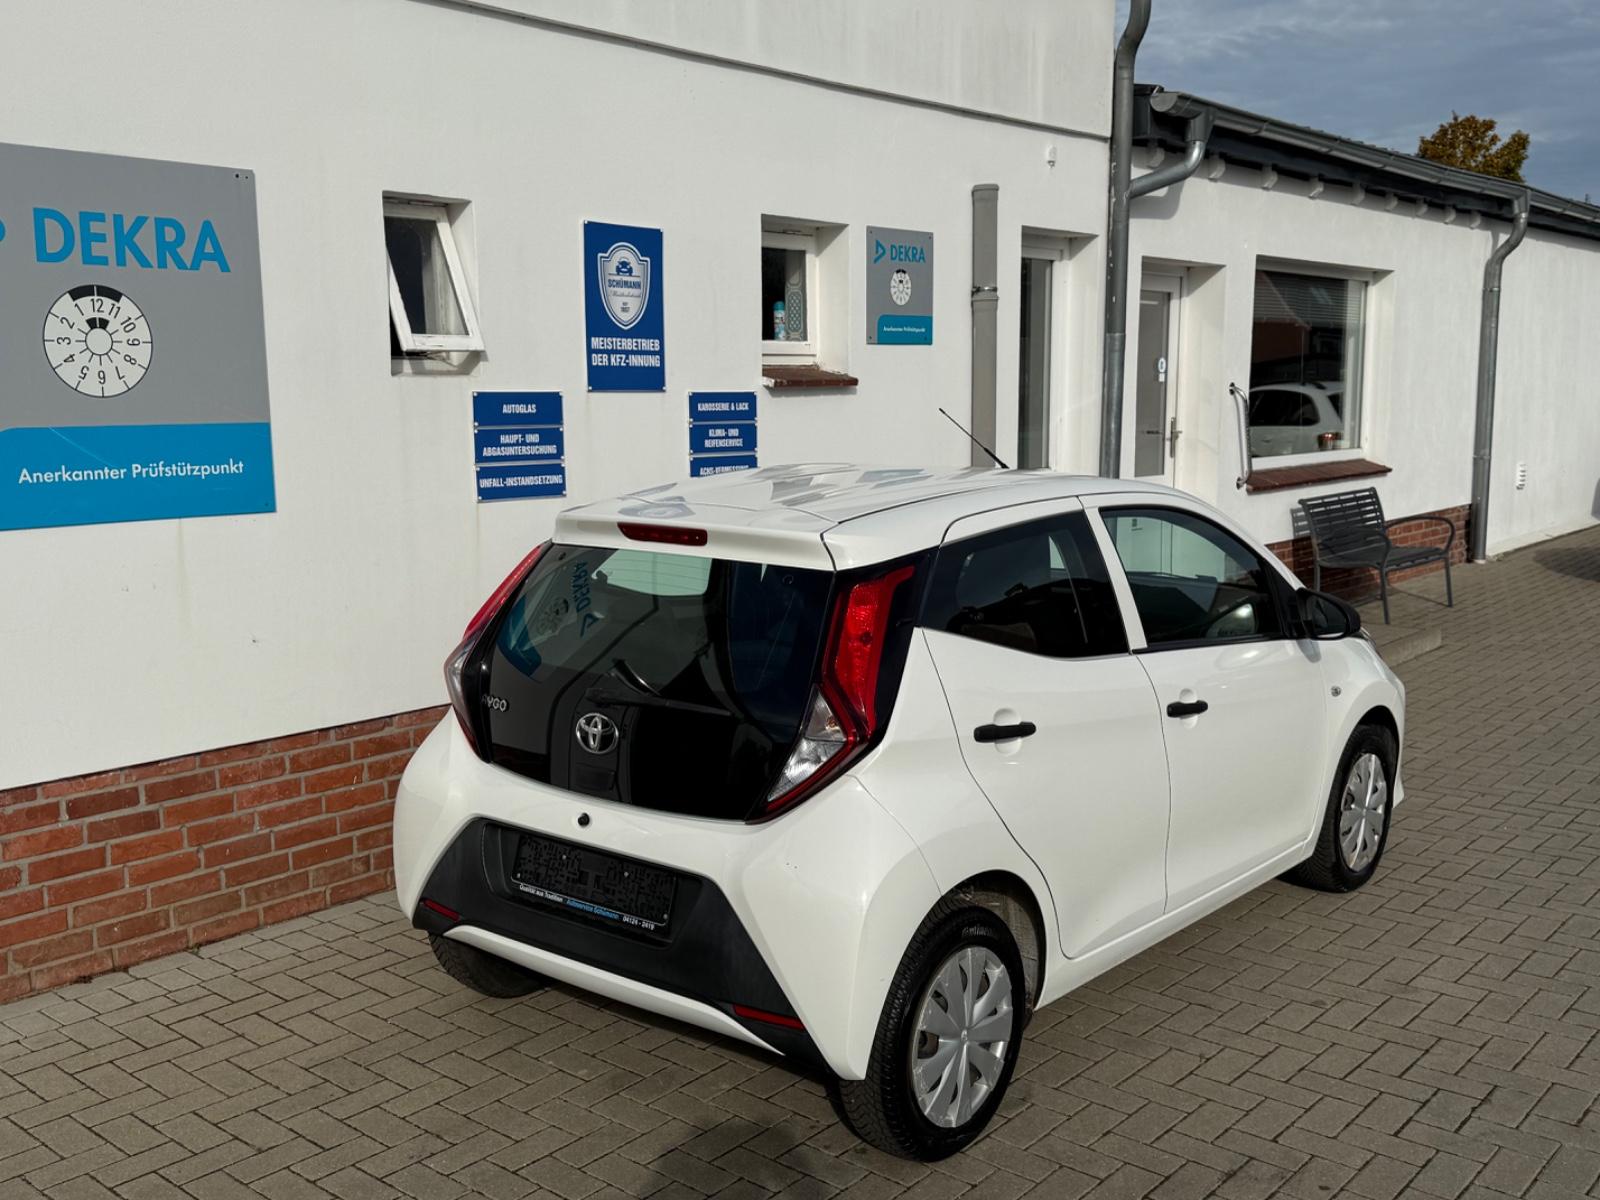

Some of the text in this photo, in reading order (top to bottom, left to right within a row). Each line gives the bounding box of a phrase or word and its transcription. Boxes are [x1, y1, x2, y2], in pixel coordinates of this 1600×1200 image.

[32, 207, 231, 272] DEKRA
[890, 244, 926, 263] DEKRA
[608, 278, 641, 289] SCHÜMANN
[74, 303, 84, 316] 1
[90, 298, 104, 313] 12
[108, 303, 121, 319] 11
[60, 317, 75, 329] 2
[120, 316, 136, 333] 10
[56, 336, 71, 345] 3
[127, 338, 141, 346] 9
[591, 337, 660, 351] MEISTERBETRIEB
[63, 353, 75, 363] 4
[123, 354, 137, 365] 8
[592, 353, 660, 367] DER KFZ-INNUNG
[78, 365, 90, 380] 5
[97, 370, 106, 385] 6
[115, 366, 125, 380] 7
[502, 404, 537, 414] AUTOGLAS
[697, 402, 750, 411] KAROSSERIE & LACK
[500, 433, 540, 443] HAUPT- UND
[708, 428, 739, 437] KLIMA- UND
[704, 438, 743, 448] REIFENSERVICE
[482, 444, 557, 457] ABGASUNTERSUCHUNG
[18, 458, 244, 484] Anerkannter Prüfstützpunkt
[480, 475, 563, 488] UNFALL-INSTANDSETZUNG
